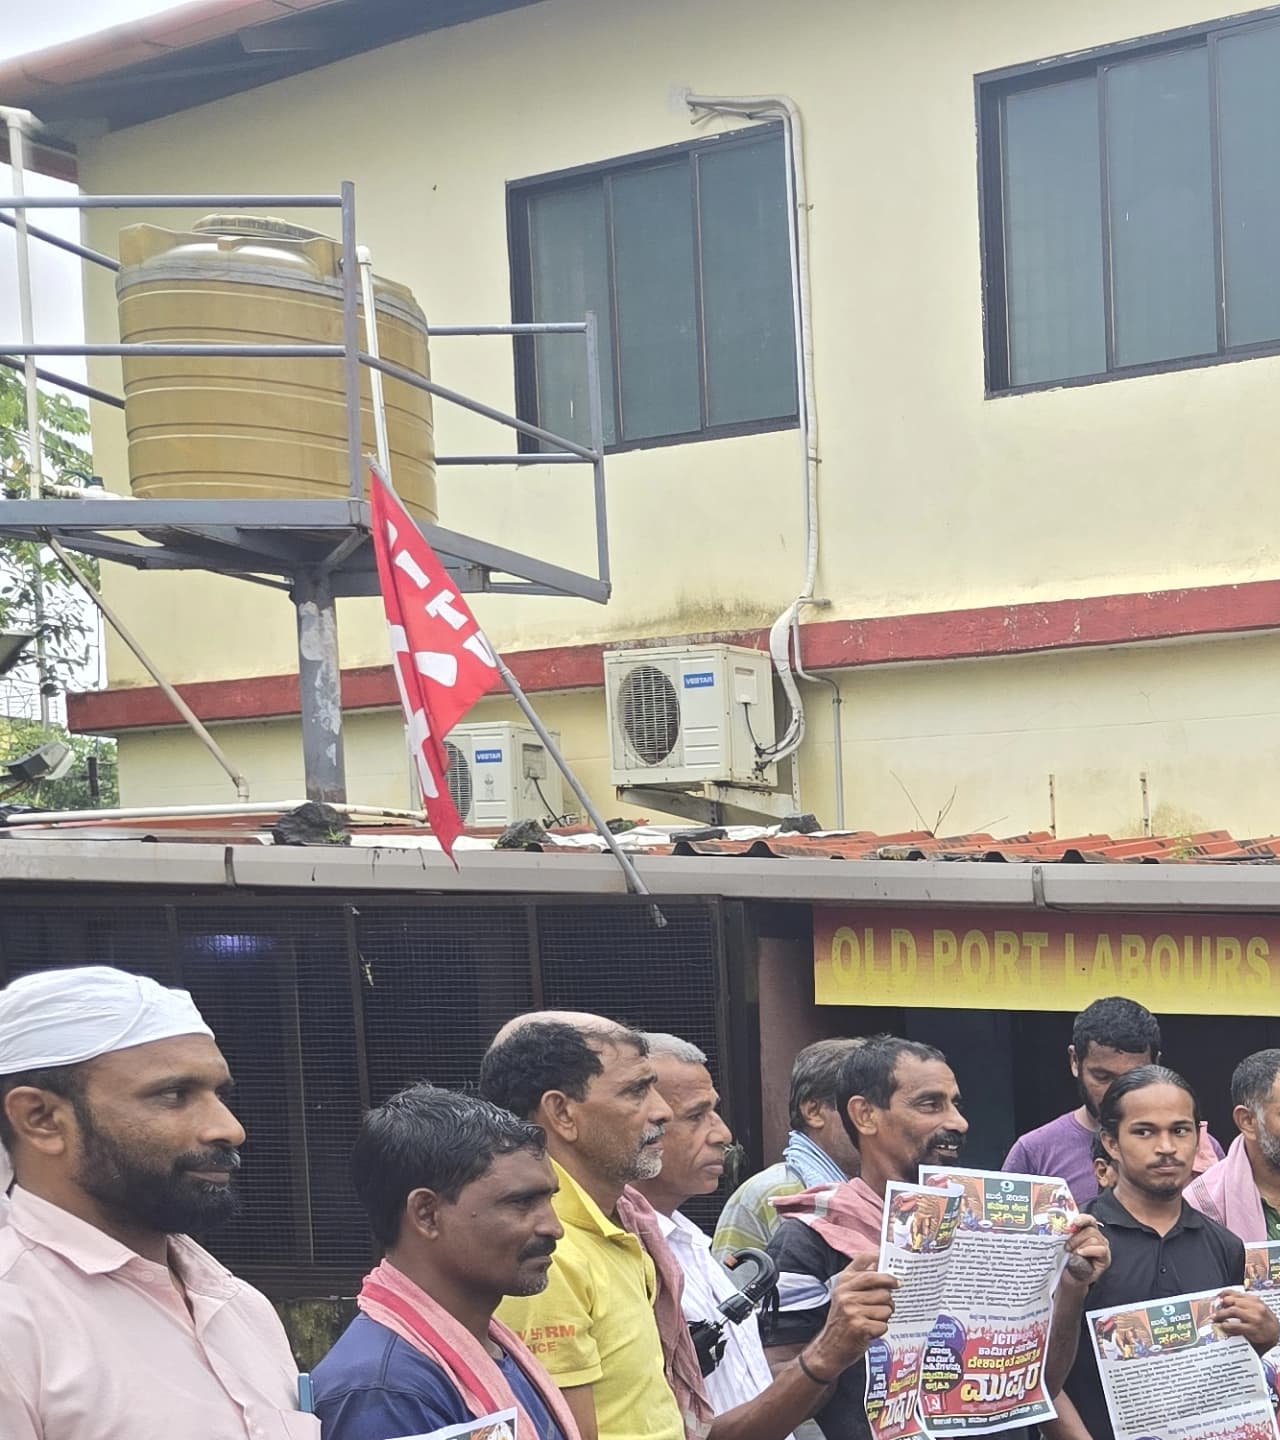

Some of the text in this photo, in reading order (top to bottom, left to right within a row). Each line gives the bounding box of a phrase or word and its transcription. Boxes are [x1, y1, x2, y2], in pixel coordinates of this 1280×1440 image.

[832, 926, 917, 989] OLD
[931, 929, 1050, 988] PORT
[1064, 931, 1270, 992] LABOURS
[1001, 1181, 1014, 1192] 9
[1162, 1305, 1175, 1315] 9
[961, 1362, 1040, 1401] ಮುಷ್ಕರ
